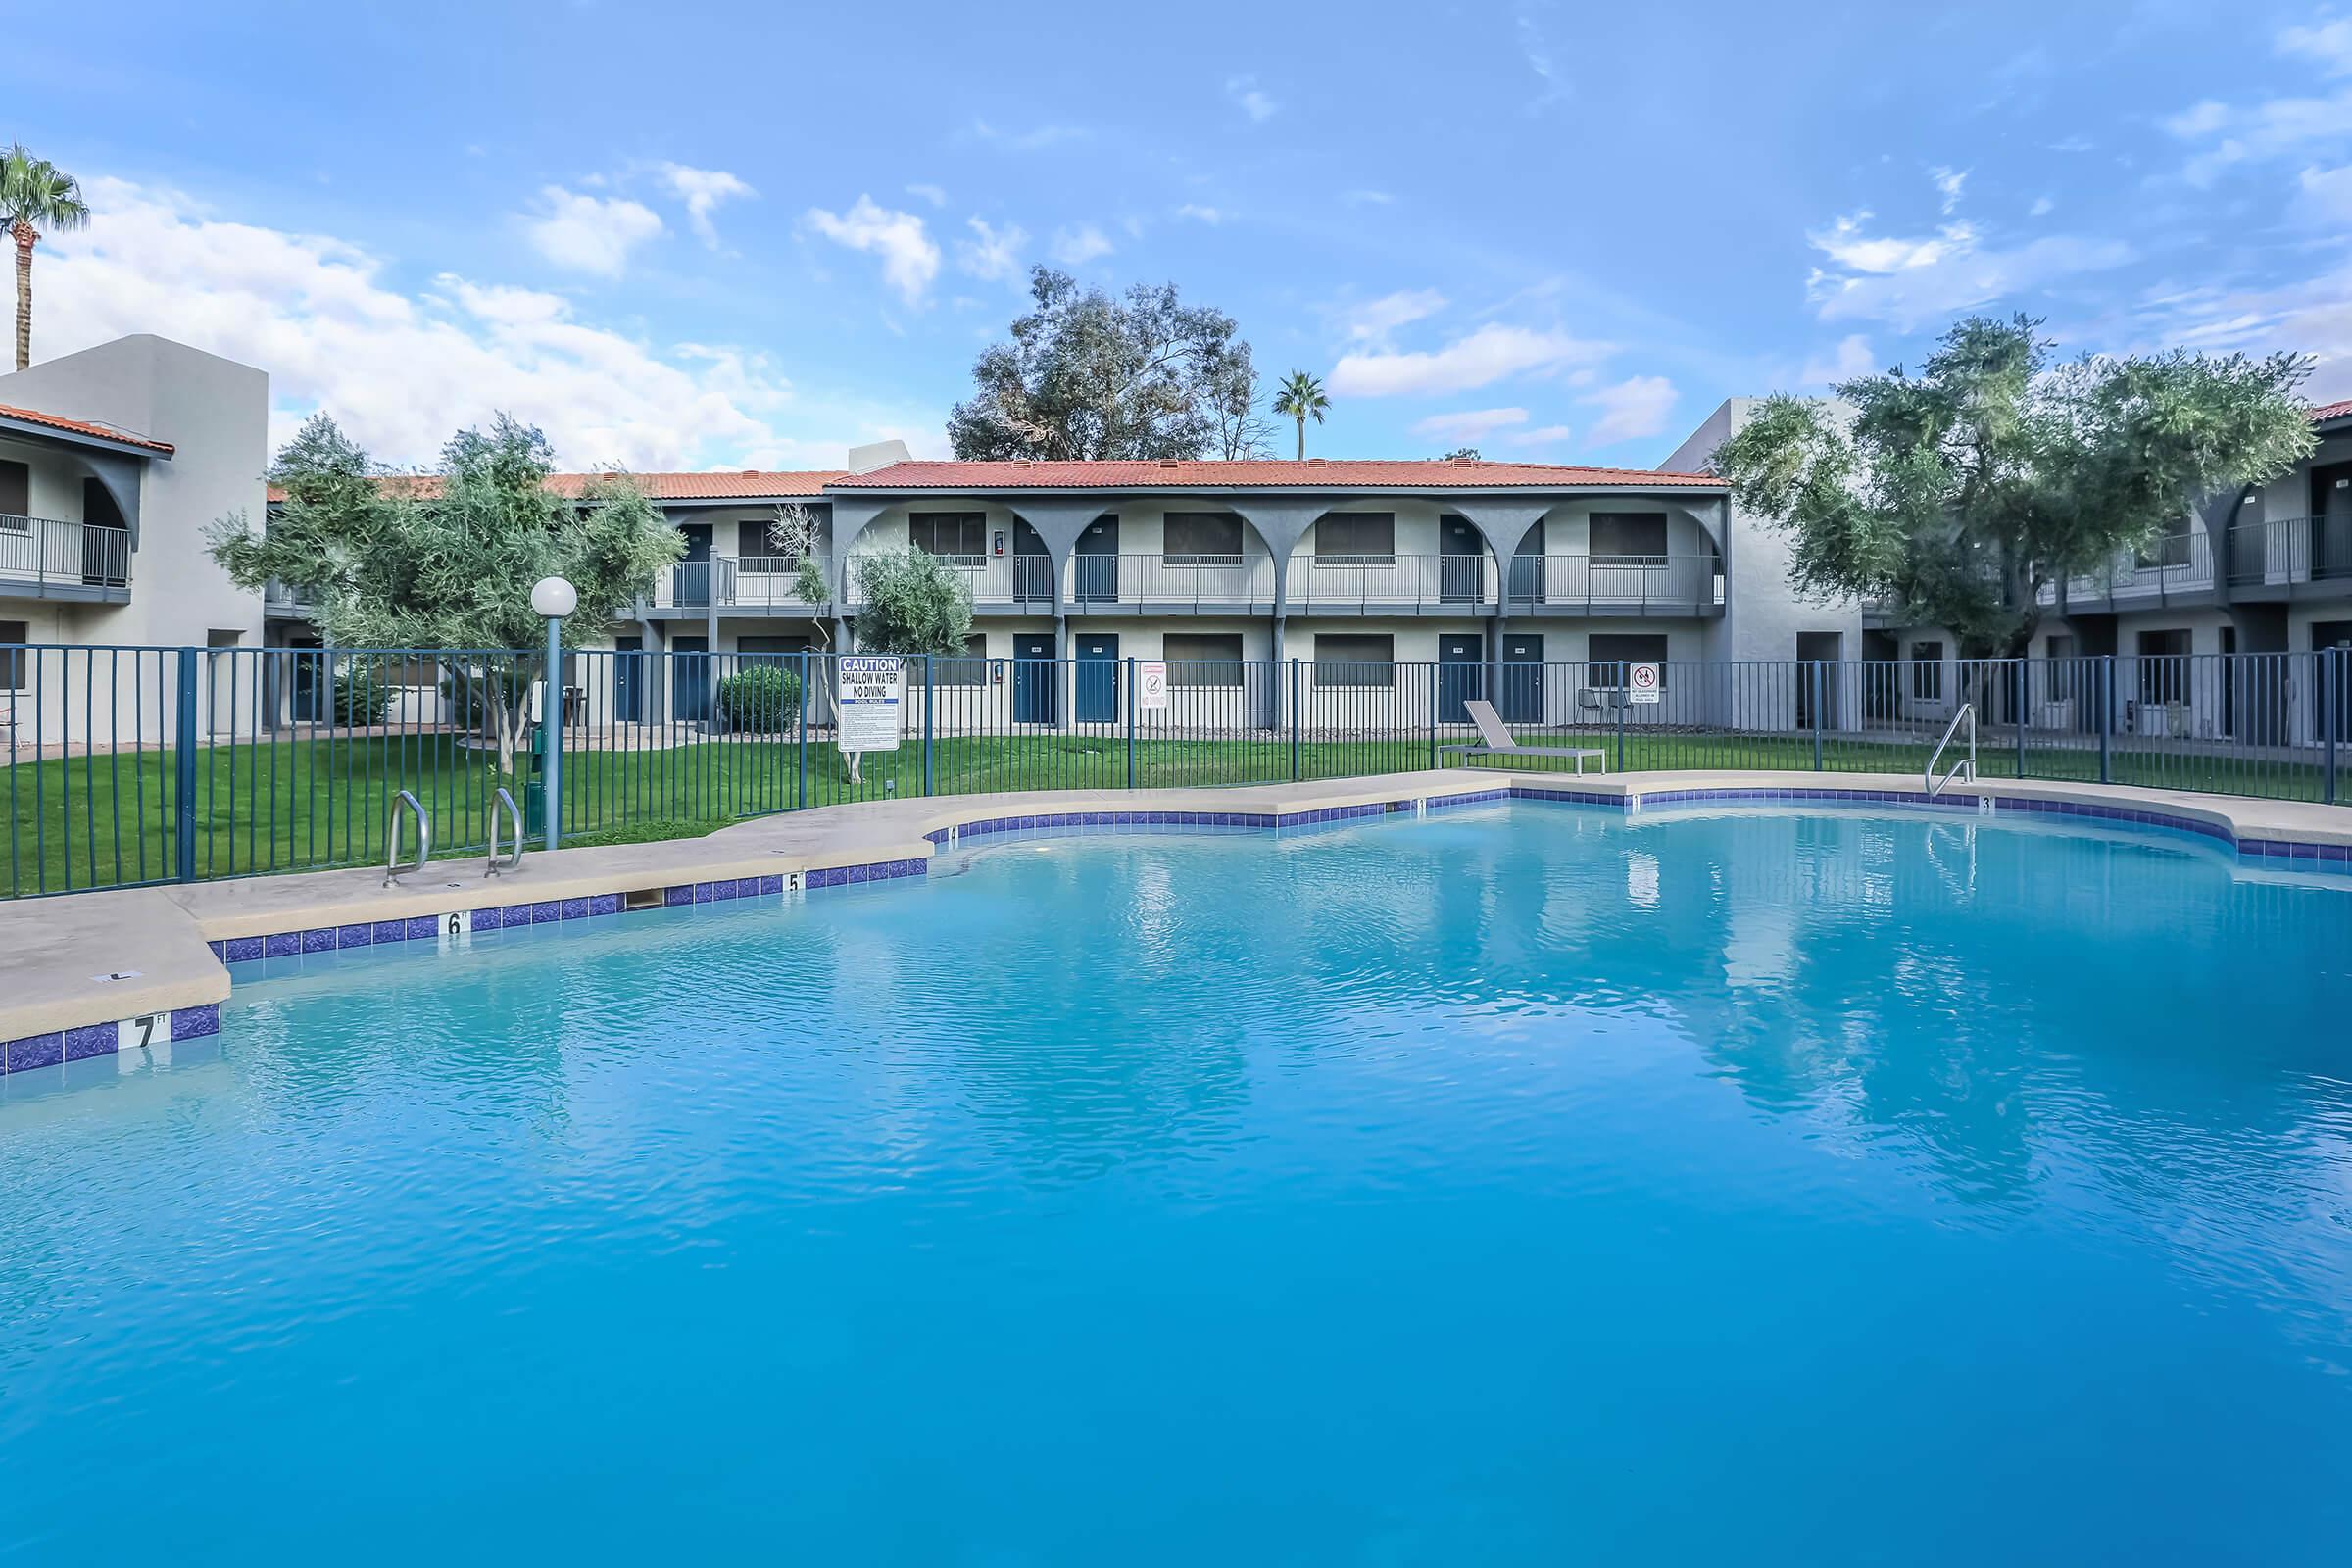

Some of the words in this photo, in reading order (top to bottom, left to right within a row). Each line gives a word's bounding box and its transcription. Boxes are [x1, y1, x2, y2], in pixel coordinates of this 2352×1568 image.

[843, 659, 896, 671] CAUTION
[842, 672, 874, 684] SHALLOW
[874, 672, 898, 684] WATER
[853, 685, 863, 697] NO
[864, 685, 886, 697] DIVING
[1984, 797, 1989, 808] 3
[952, 827, 956, 840] 4
[790, 874, 798, 891] 5
[449, 913, 460, 935] 6
[135, 1016, 154, 1048] 7
[157, 1013, 167, 1024] FT
